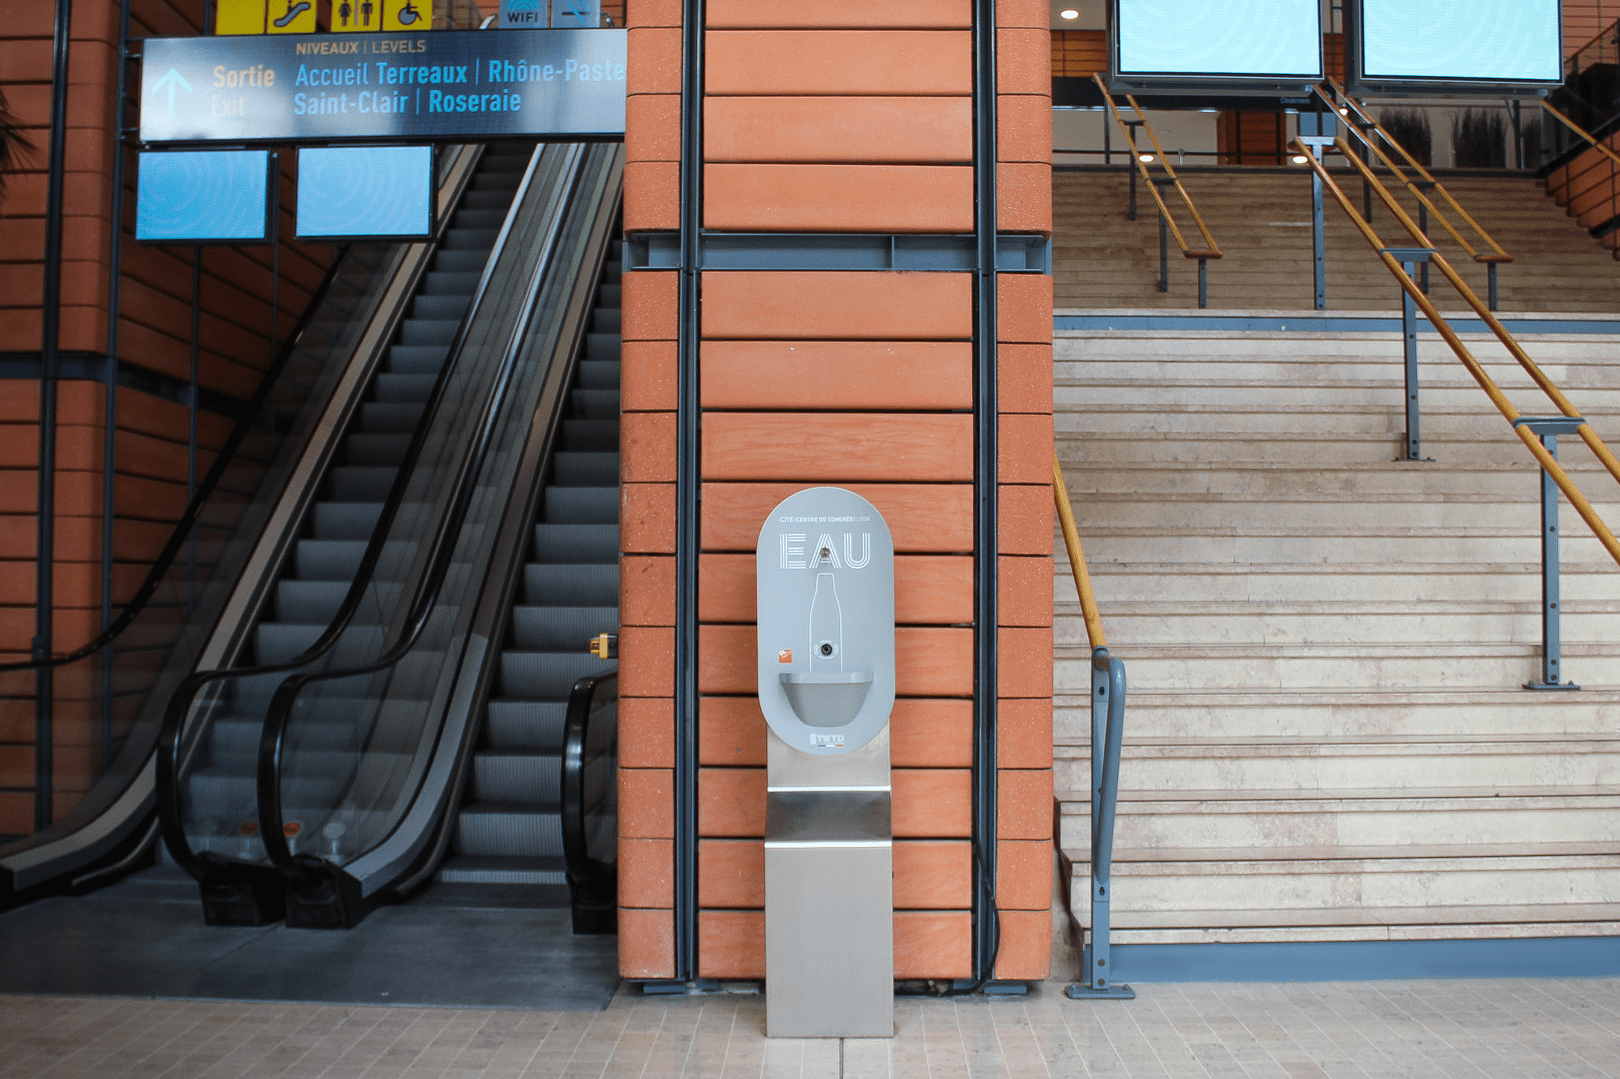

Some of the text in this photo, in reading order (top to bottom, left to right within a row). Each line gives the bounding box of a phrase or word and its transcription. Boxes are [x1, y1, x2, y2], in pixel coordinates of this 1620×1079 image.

[507, 12, 538, 23] WIFI
[296, 40, 426, 55] NIVEAUX LEVELS
[213, 65, 275, 88] Sortie
[295, 62, 369, 86] Accueil
[376, 61, 467, 84] Terreaux
[211, 94, 246, 117] Exit
[294, 89, 522, 115] Saint-Clair Roseraie
[779, 533, 870, 569] EAU
